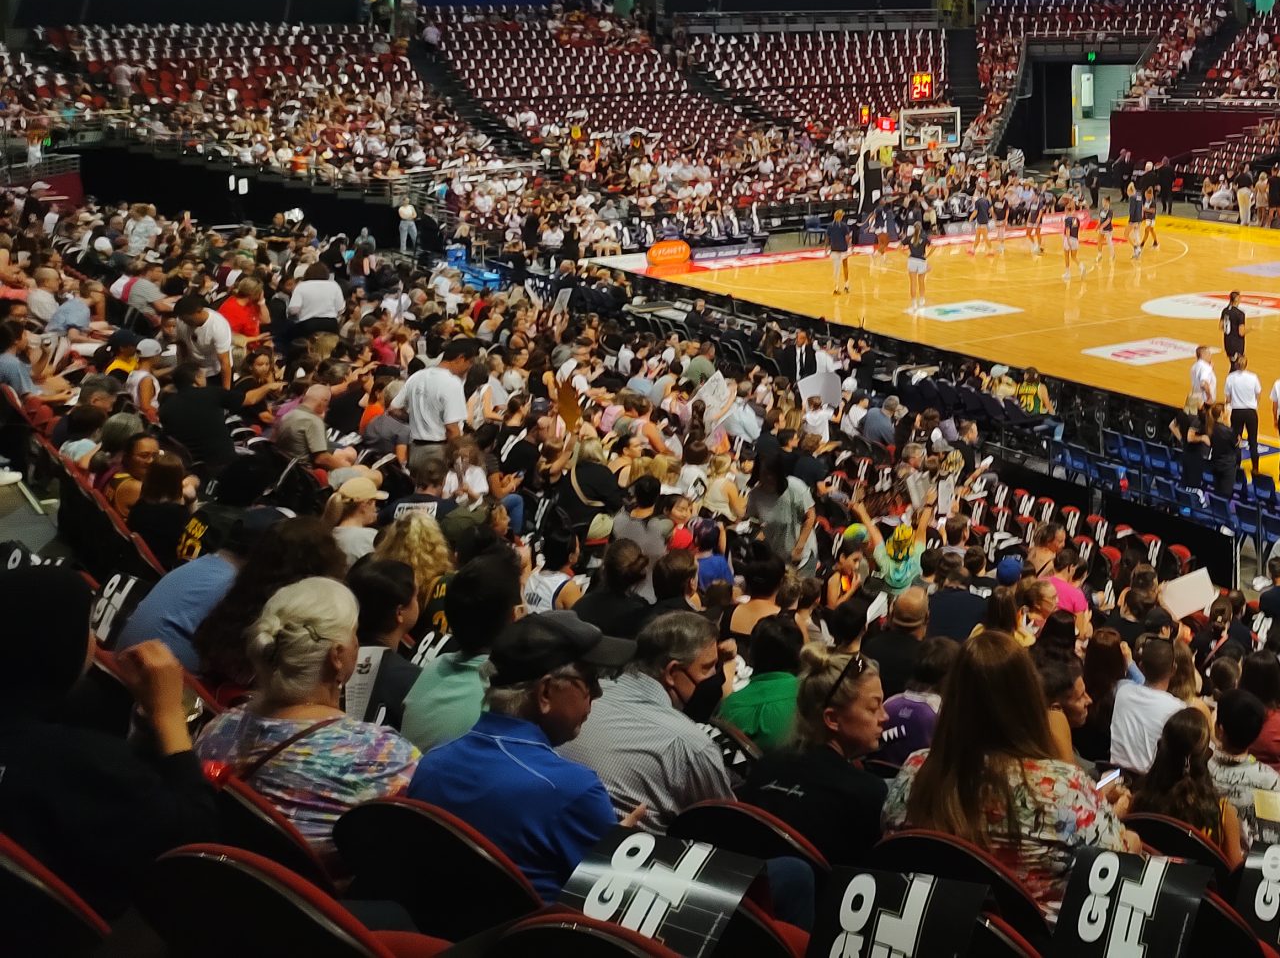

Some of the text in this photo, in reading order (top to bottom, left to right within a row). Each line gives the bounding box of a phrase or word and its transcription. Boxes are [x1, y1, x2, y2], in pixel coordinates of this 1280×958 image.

[913, 84, 929, 98] 24
[583, 832, 656, 922] GO
[1078, 851, 1120, 943] GO
